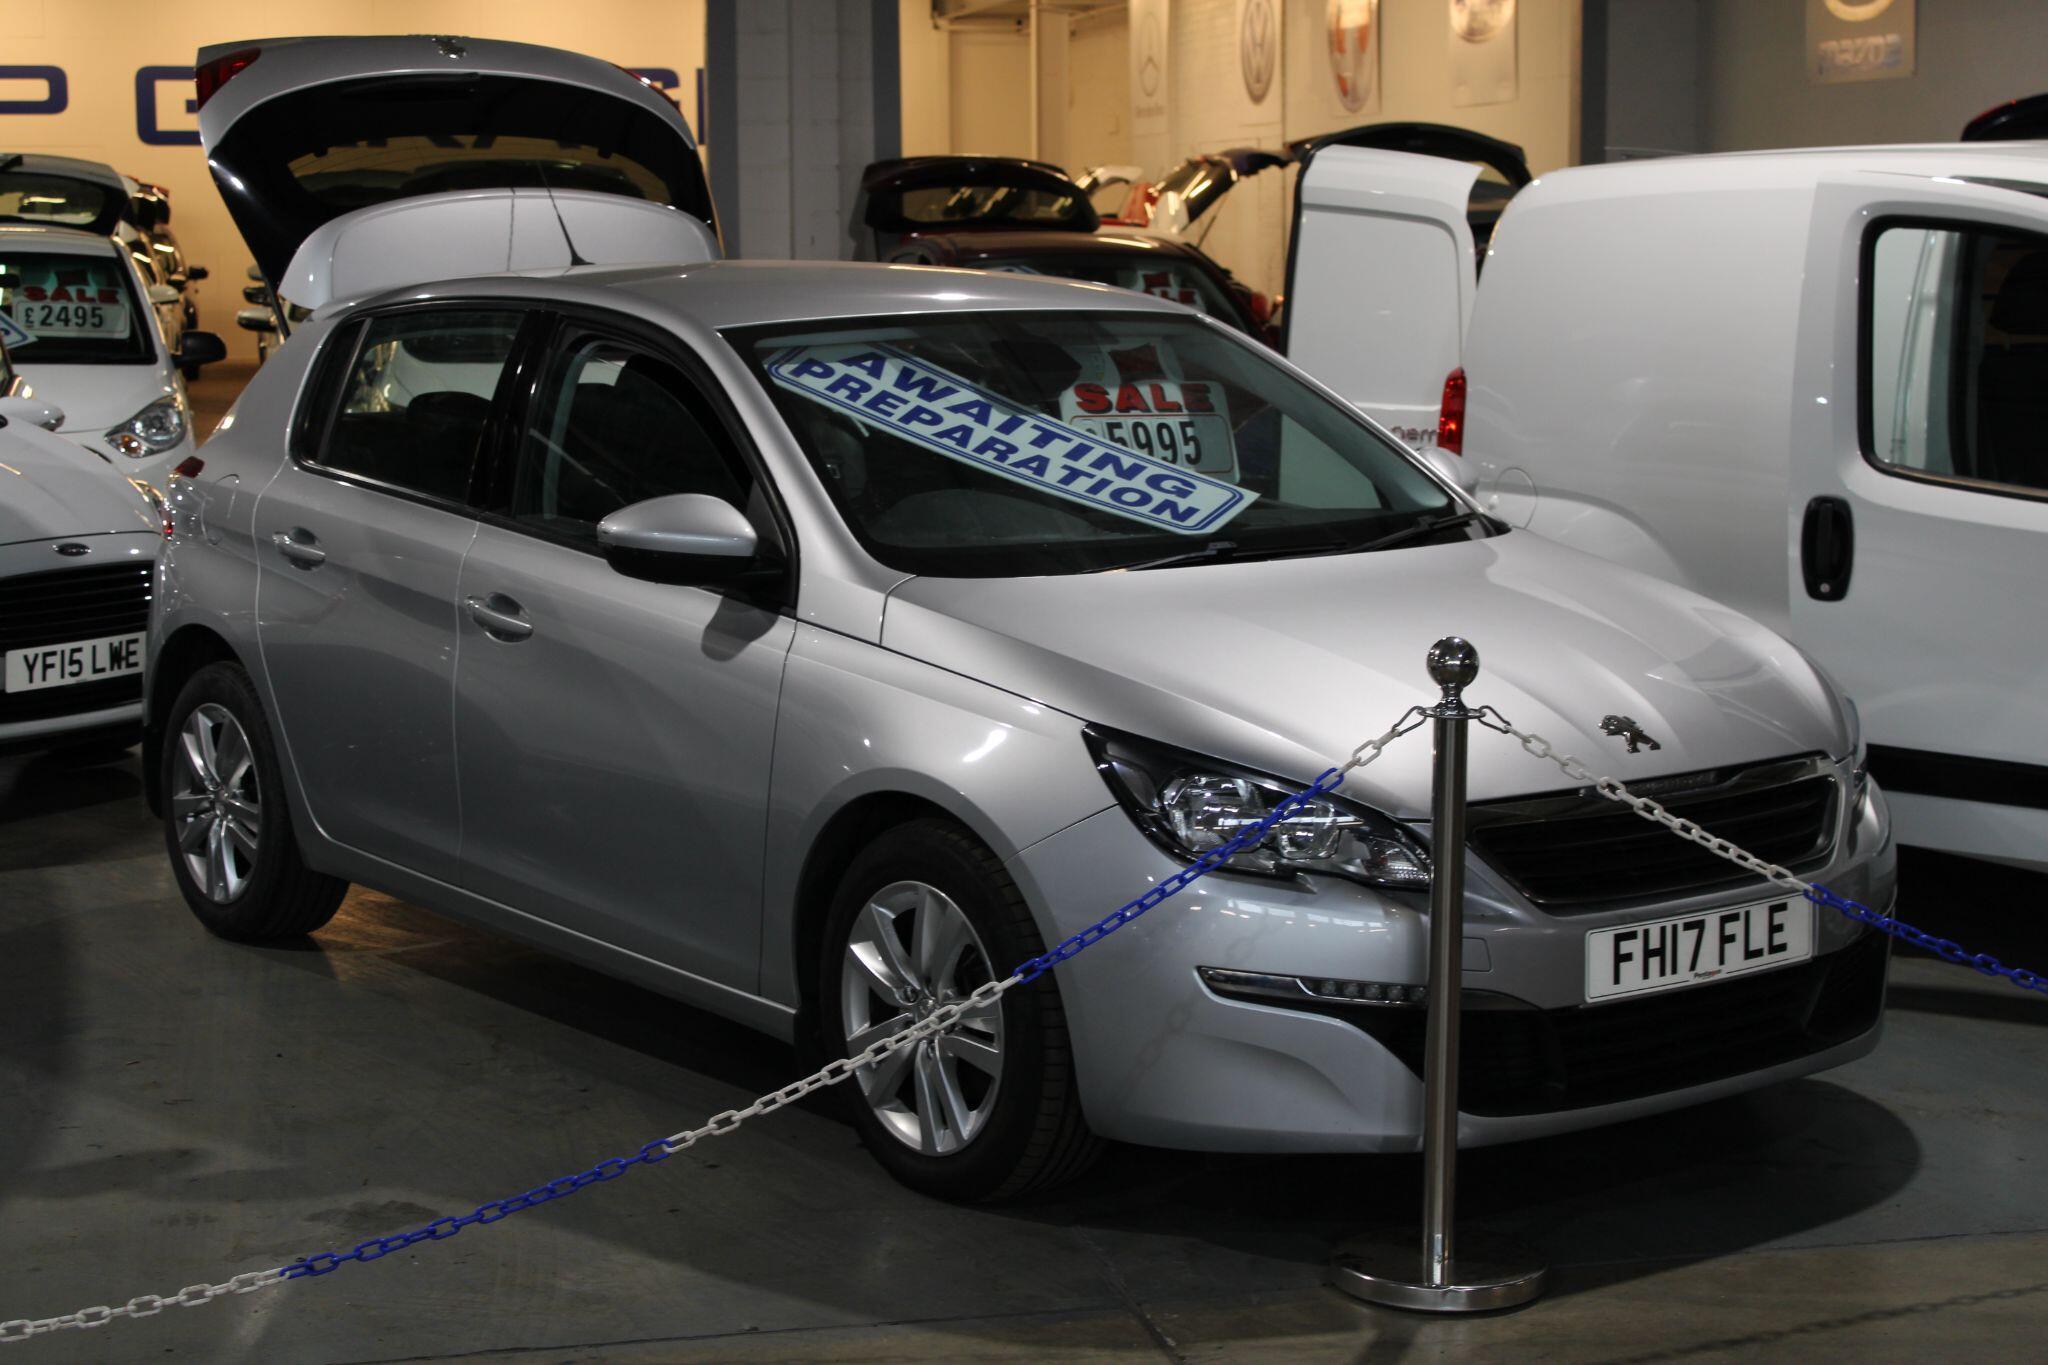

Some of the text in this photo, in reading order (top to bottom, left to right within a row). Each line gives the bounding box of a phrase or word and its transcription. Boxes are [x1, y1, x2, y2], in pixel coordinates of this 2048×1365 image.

[23, 286, 121, 304] SALE
[1073, 383, 1216, 414] SALE
[788, 357, 1200, 523] PREPARATION
[837, 351, 1198, 500] AWAITING
[1085, 421, 1202, 466] 5995
[23, 638, 139, 684] YF15 LWE
[1613, 902, 1788, 985] FH17 FLE
